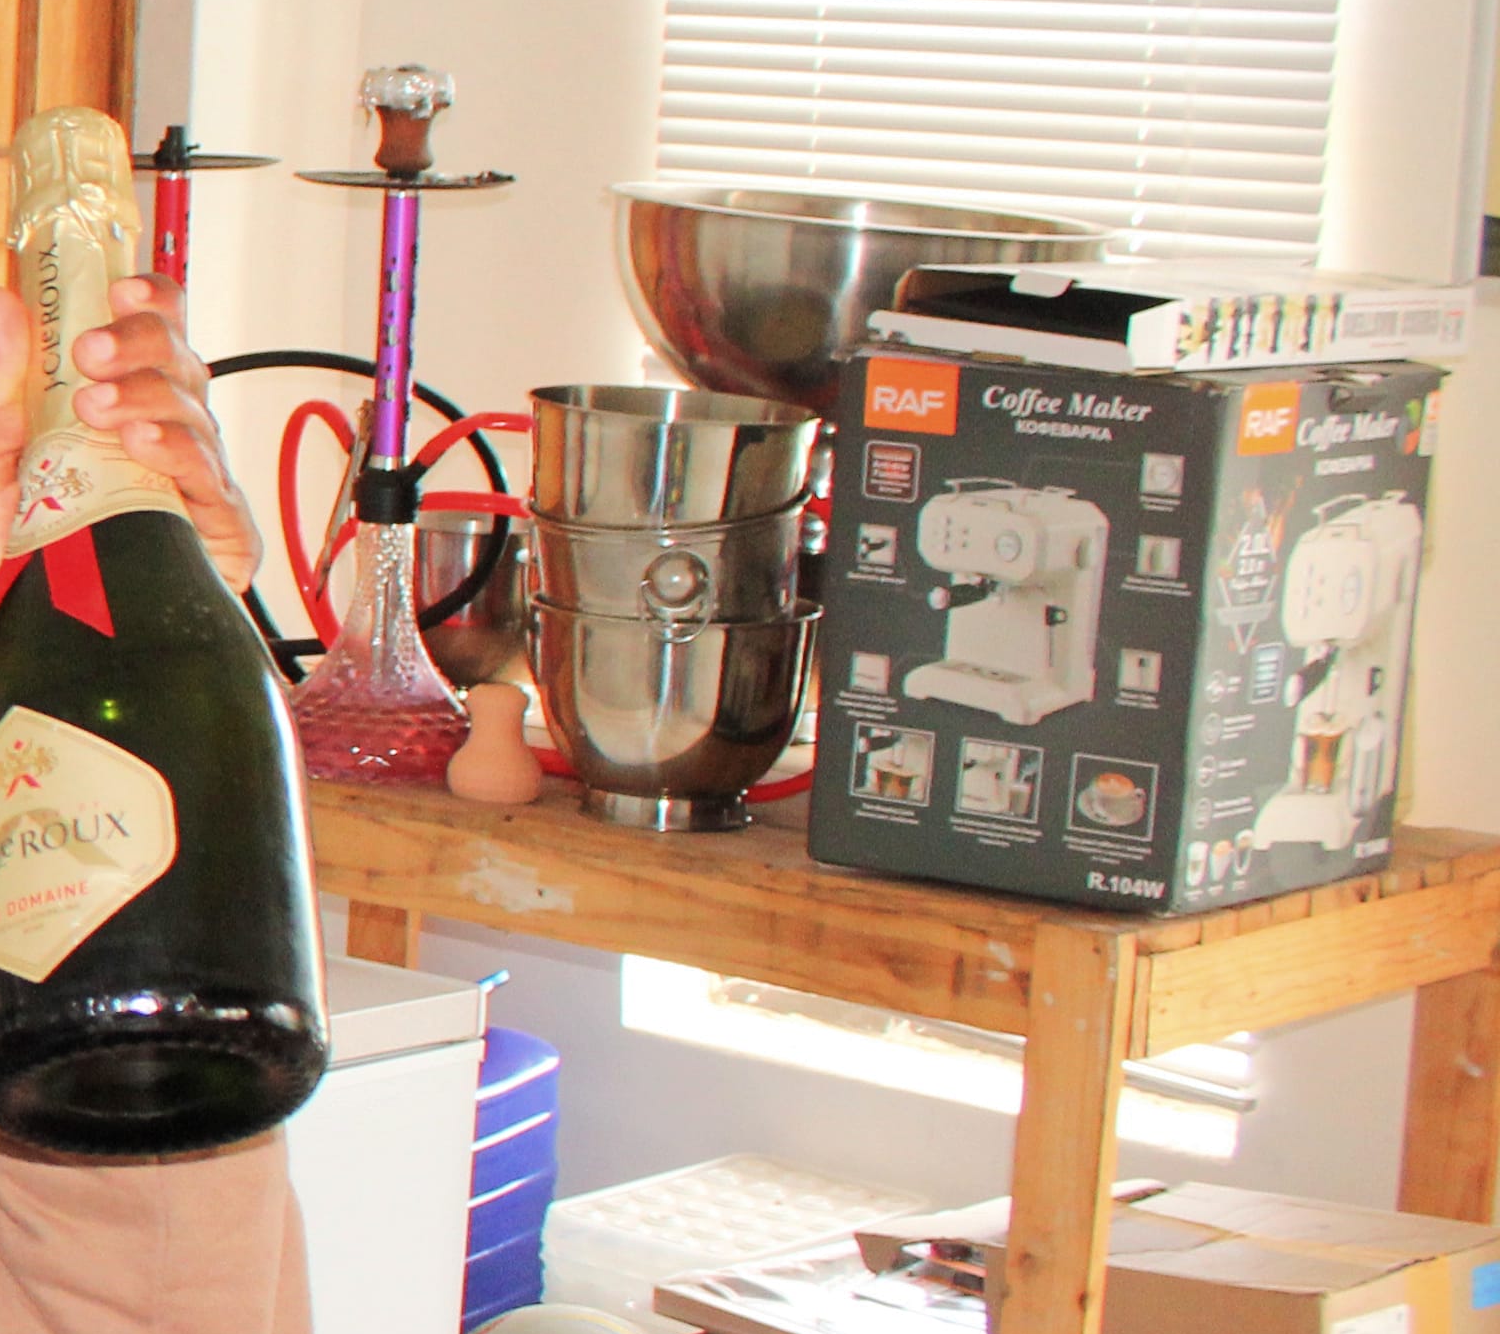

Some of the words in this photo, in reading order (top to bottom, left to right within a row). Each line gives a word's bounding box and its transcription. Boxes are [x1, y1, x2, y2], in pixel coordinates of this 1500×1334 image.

[873, 386, 946, 416] RAF
[981, 384, 1061, 418] Coffee
[1067, 392, 1152, 424] Maker
[1244, 407, 1292, 440] RAF
[1296, 415, 1351, 452] Coffee
[1087, 871, 1165, 900] R.104W
